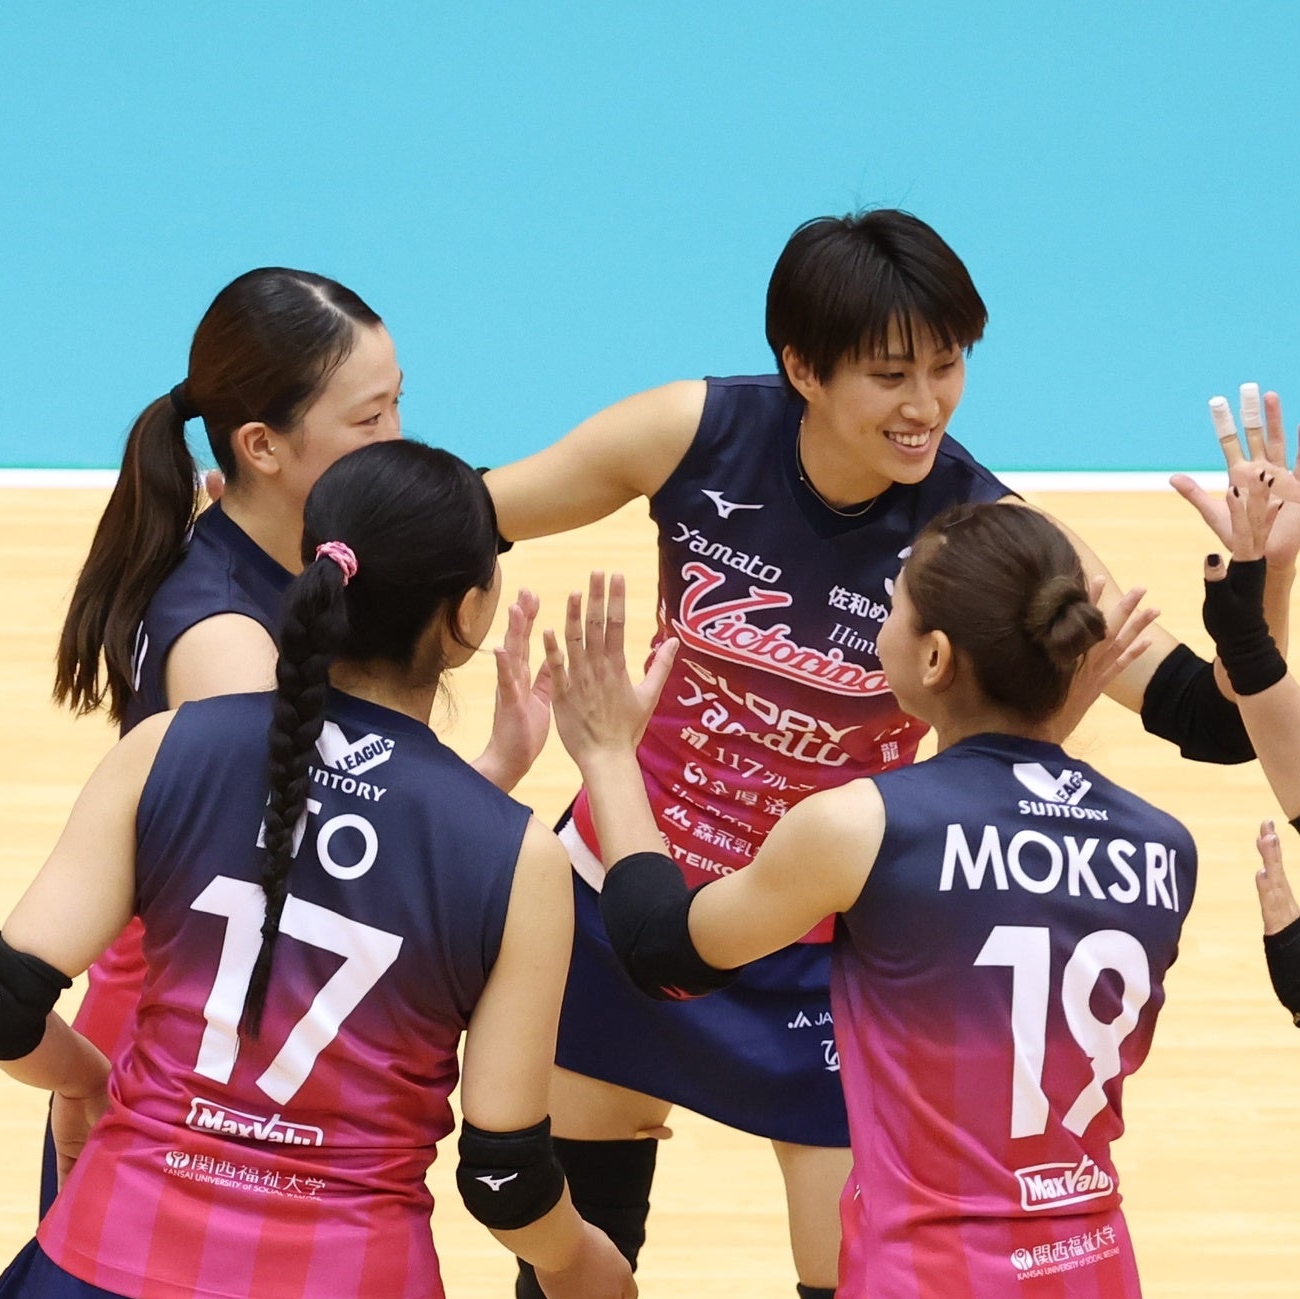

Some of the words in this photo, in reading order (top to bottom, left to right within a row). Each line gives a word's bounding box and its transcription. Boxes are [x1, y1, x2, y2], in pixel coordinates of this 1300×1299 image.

[939, 824, 1180, 912] MOKSRI
[189, 875, 404, 1107] 17
[973, 925, 1152, 1139] 19
[191, 1153, 326, 1195] 関西福祉大学
[1033, 1224, 1116, 1266] 関西福祉大学
